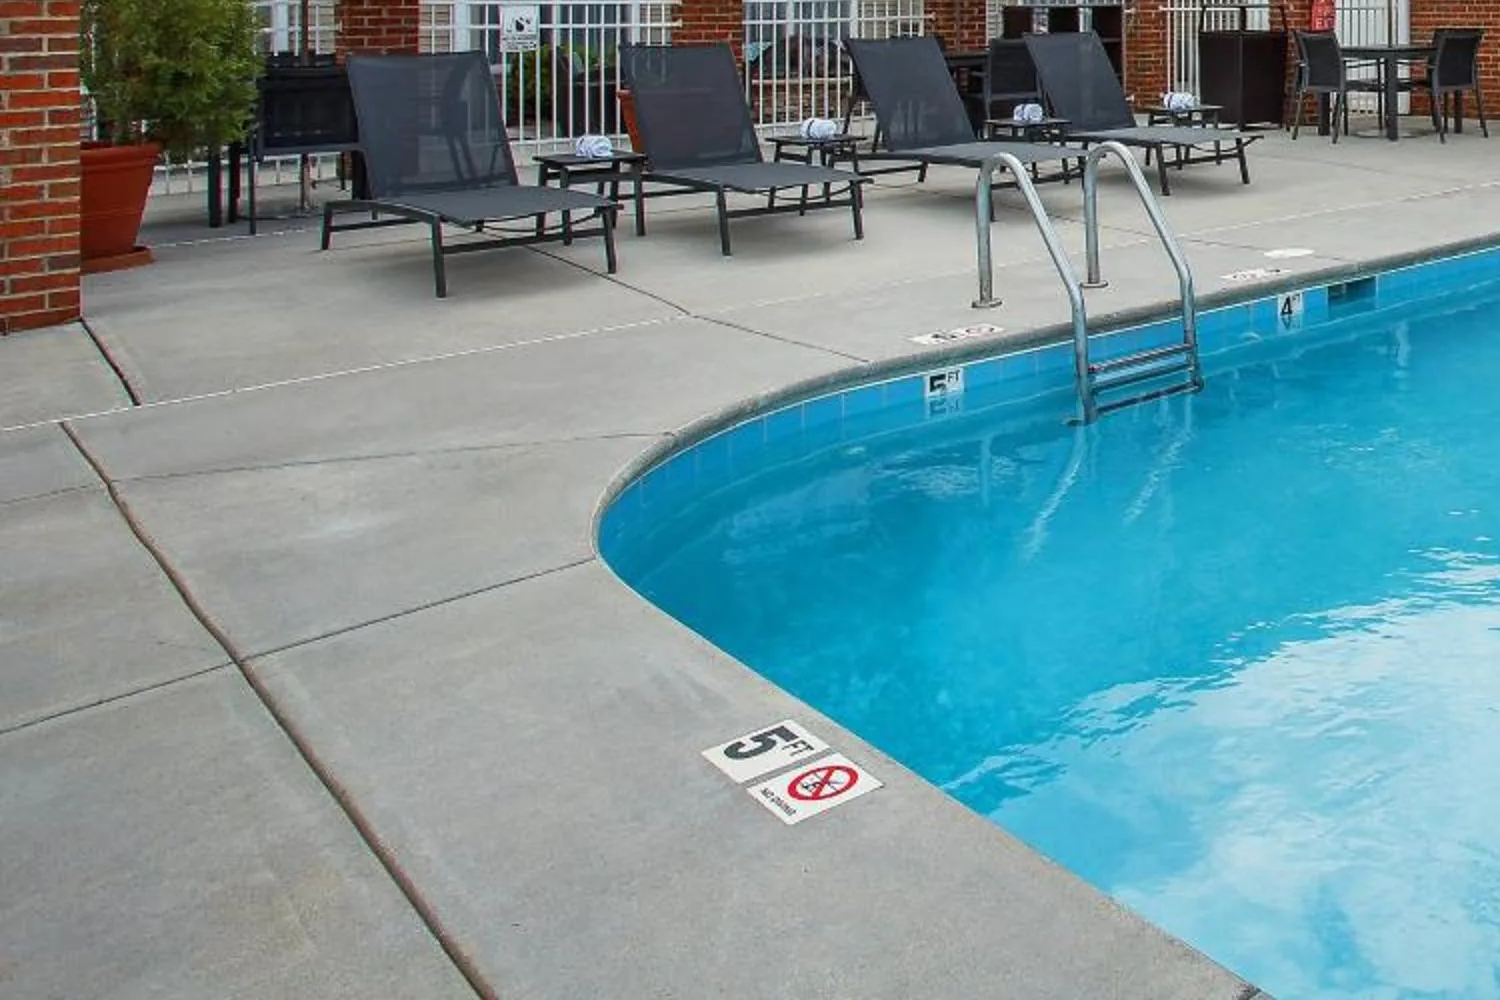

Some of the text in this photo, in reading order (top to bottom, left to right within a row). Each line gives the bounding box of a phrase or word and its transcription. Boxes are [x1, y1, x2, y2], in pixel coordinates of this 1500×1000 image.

[1280, 296, 1293, 315] 4
[930, 370, 960, 397] 5 FT
[723, 725, 815, 759] 5 FT
